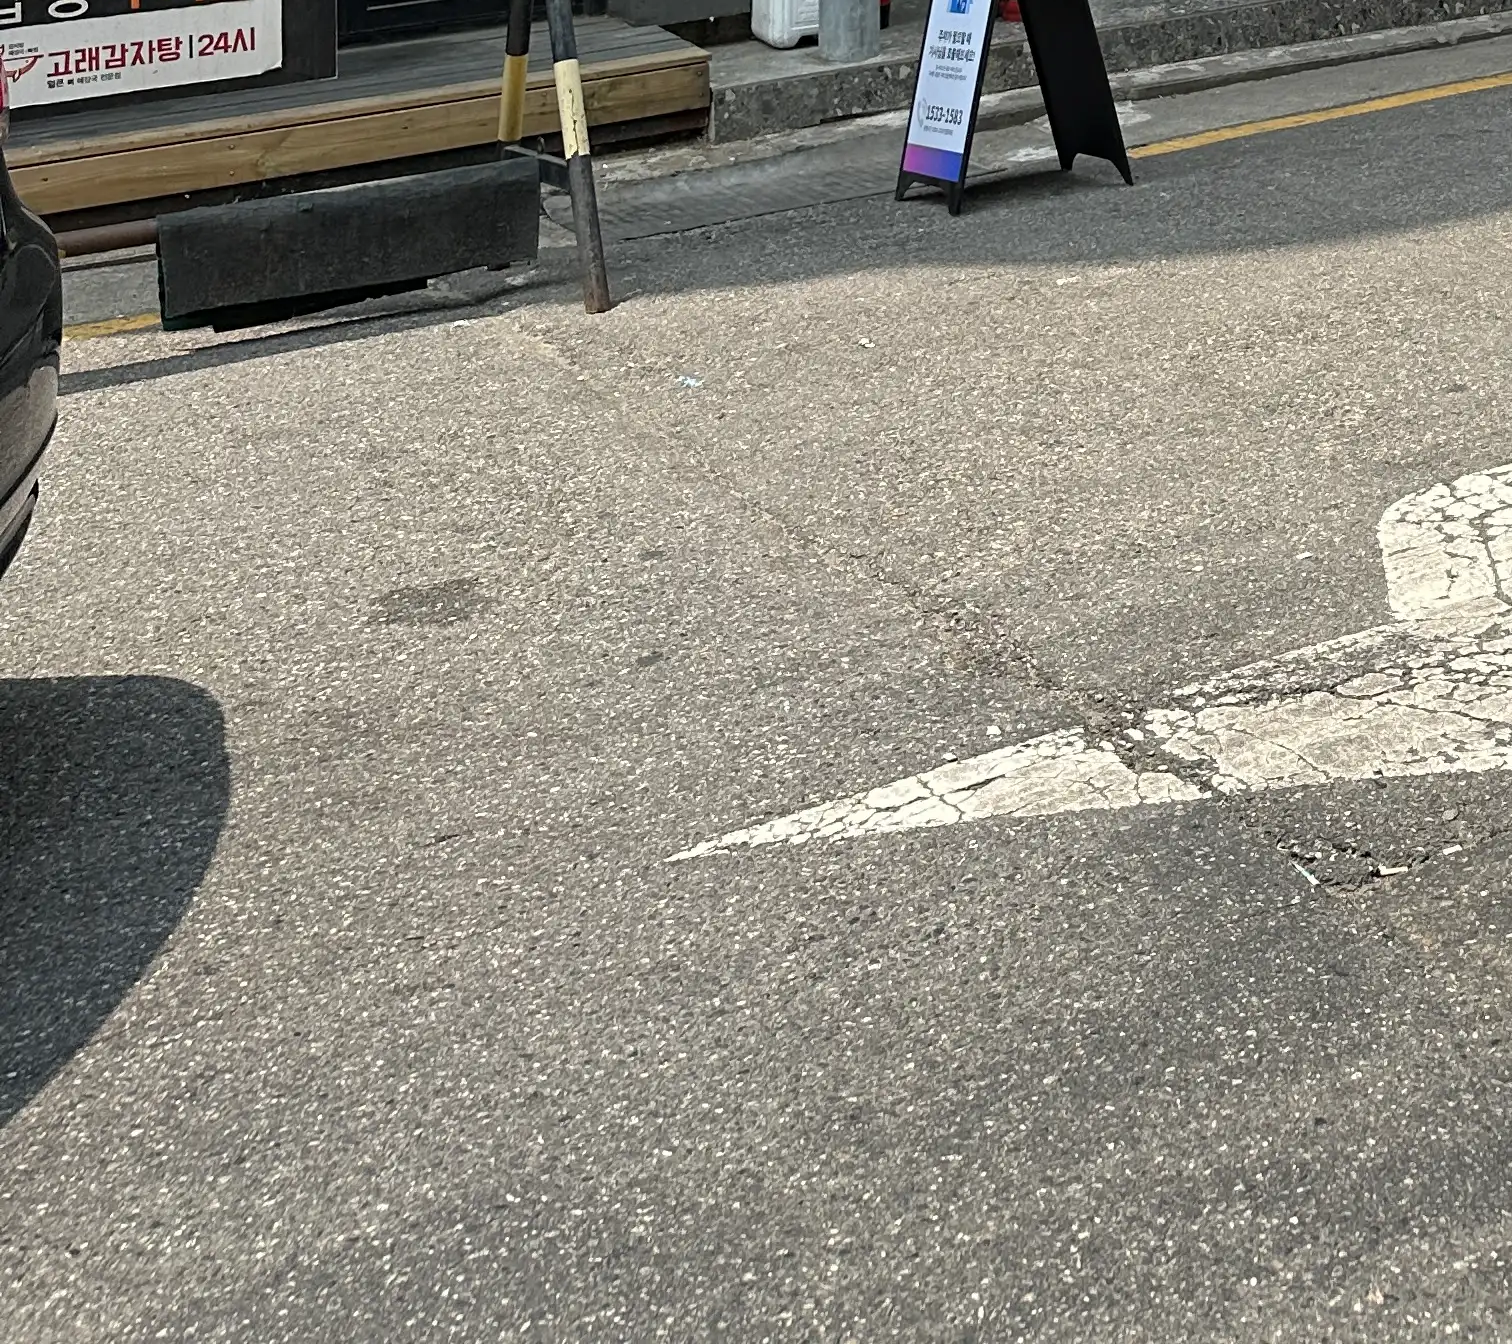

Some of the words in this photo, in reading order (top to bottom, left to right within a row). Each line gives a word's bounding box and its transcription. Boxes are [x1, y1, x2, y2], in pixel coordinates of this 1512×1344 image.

[46, 35, 184, 79] 고래감자탕
[198, 26, 257, 58] 24시
[926, 104, 964, 126] 1533-1583
